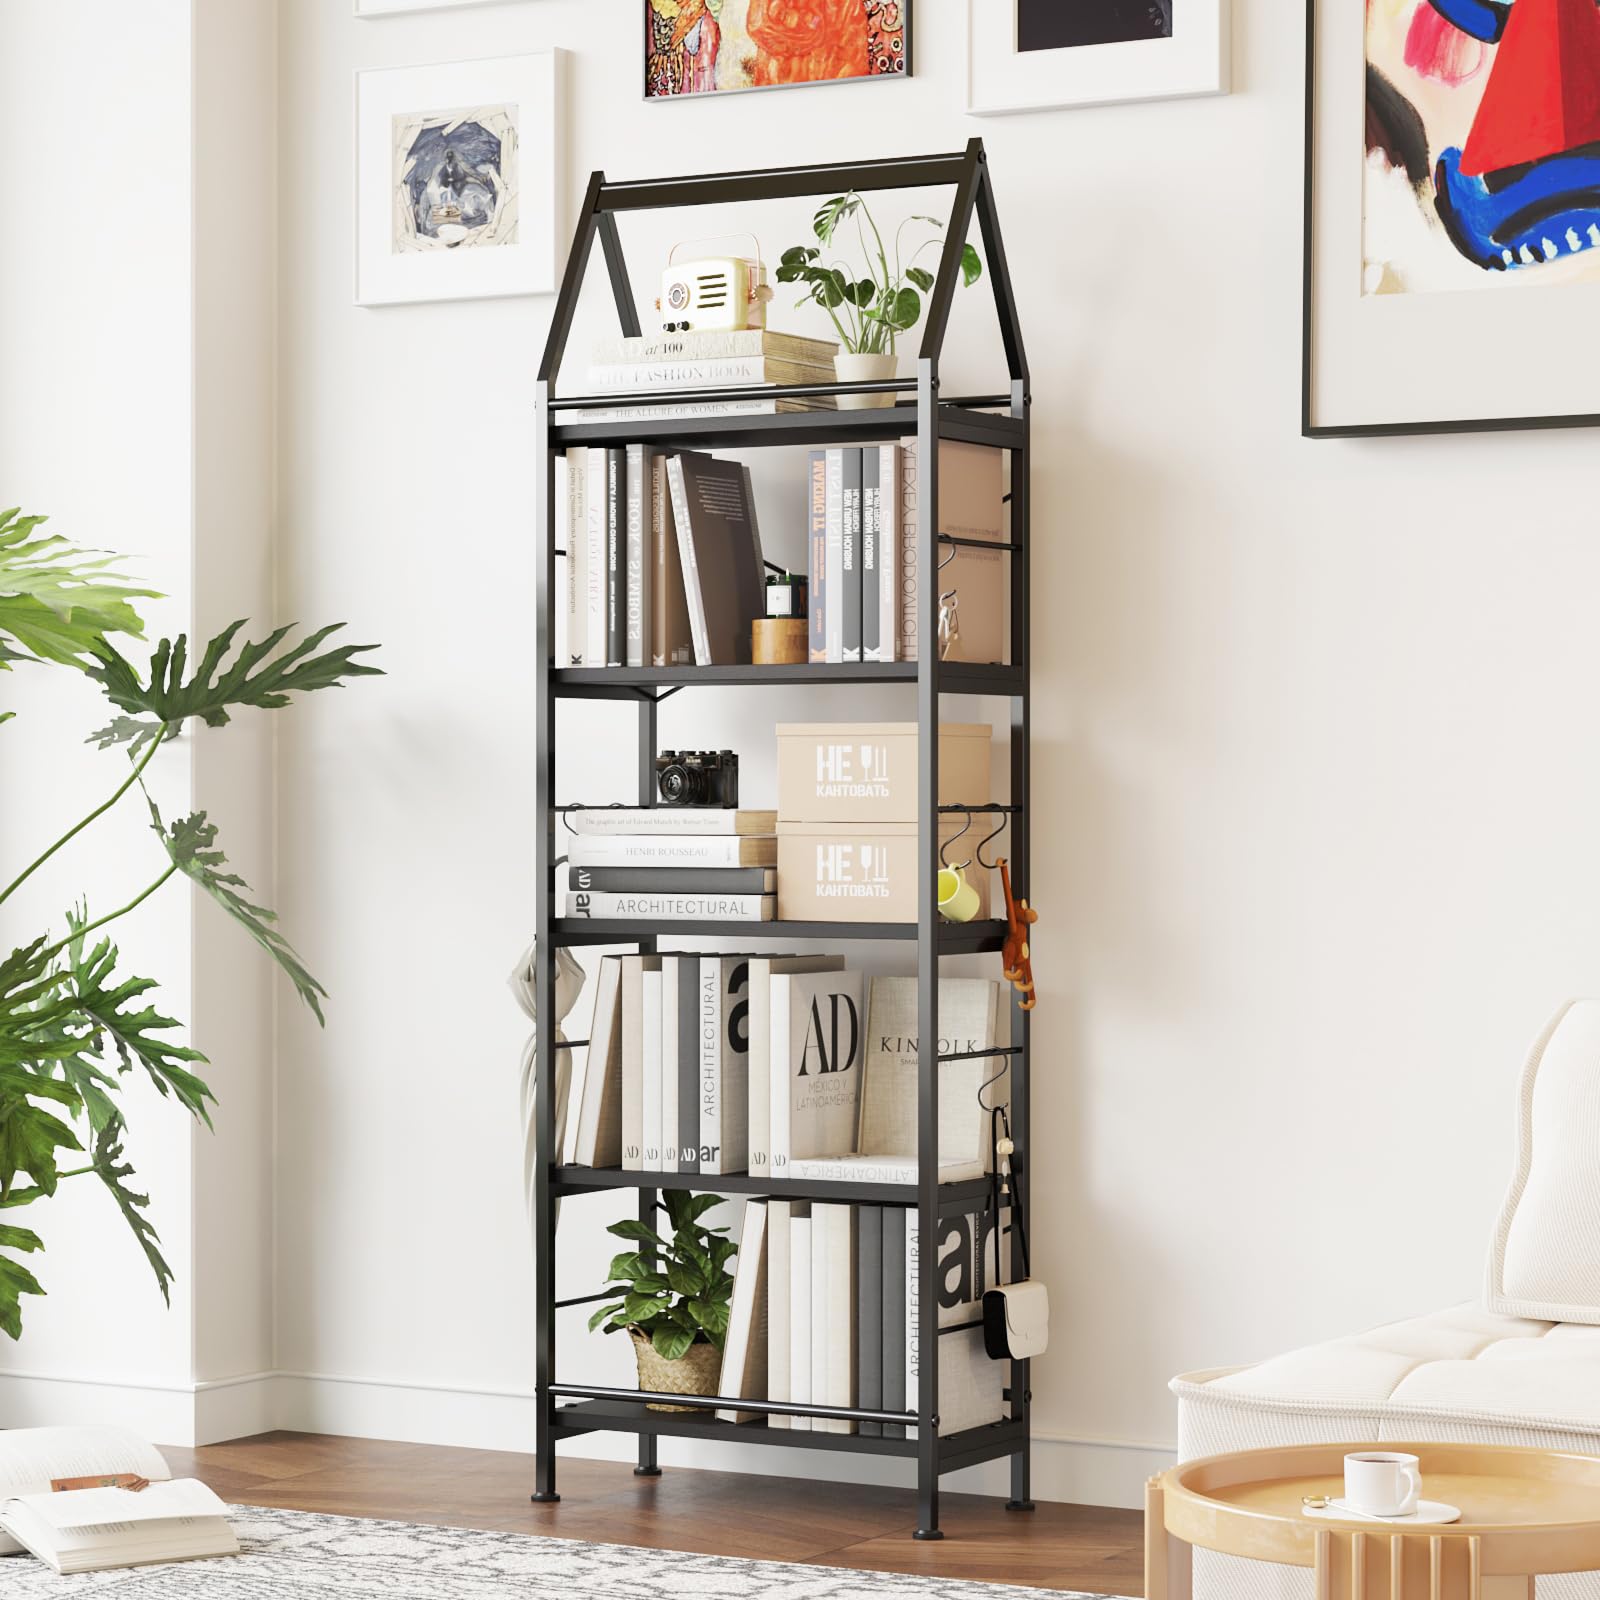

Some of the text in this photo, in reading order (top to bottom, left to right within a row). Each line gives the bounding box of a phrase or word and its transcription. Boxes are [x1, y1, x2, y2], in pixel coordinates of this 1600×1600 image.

[663, 342, 683, 354] 100
[634, 366, 703, 384] FASHION
[709, 365, 752, 378] BOOK
[616, 410, 633, 418] THE
[636, 407, 674, 417] ALLURE
[675, 406, 688, 416] OF
[691, 403, 729, 415] WOMEN
[816, 744, 853, 782] НЕ
[816, 784, 889, 798] КАНТОВАТЬ
[625, 847, 709, 858] HENRI ROUSSEAU
[816, 844, 853, 881] НЕ
[816, 883, 890, 897] КАНТОВАТЬ
[616, 899, 748, 915] ARCHITECTURAL
[797, 993, 859, 1077] AD
[703, 970, 716, 1116] ARCHITECTURAL
[880, 1036, 978, 1053] KINOLK
[624, 1146, 639, 1159] AD
[644, 1148, 658, 1161] AD
[664, 1147, 676, 1160] AD
[680, 1147, 697, 1162] AD
[700, 1144, 721, 1162] ar
[751, 1151, 766, 1165] AD
[773, 1153, 786, 1167] AD
